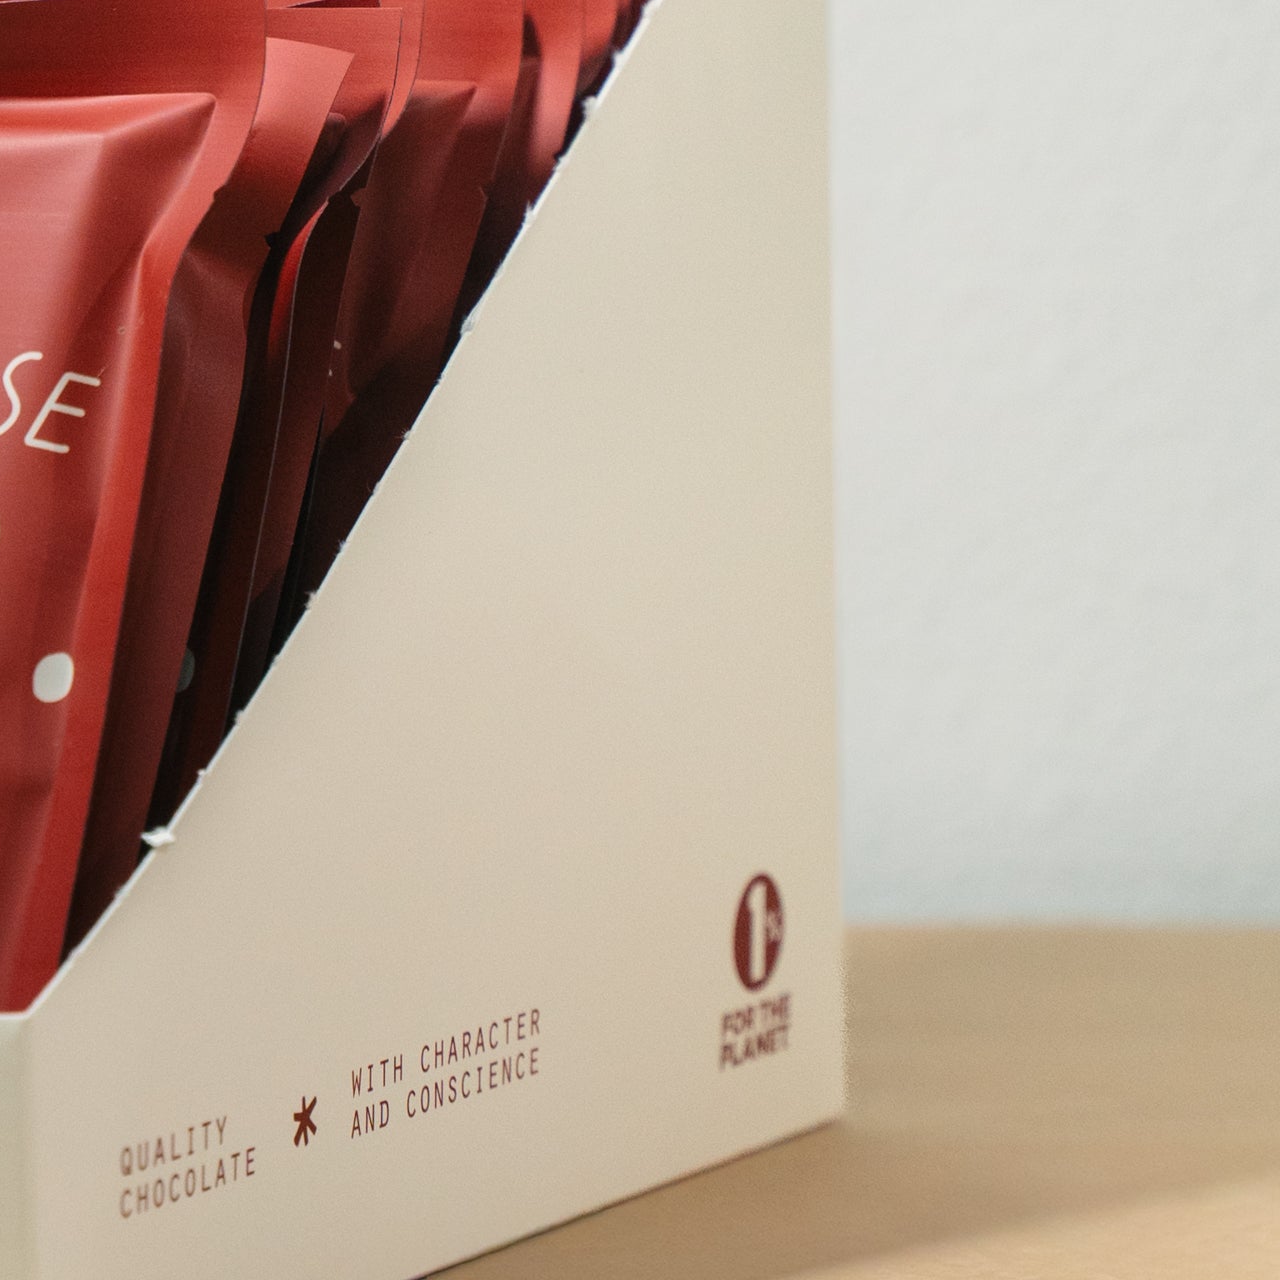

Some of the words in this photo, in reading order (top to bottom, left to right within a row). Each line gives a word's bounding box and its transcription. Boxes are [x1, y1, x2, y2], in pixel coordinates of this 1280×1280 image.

[350, 1053, 404, 1099] WITH
[420, 1008, 541, 1073] CHARACTER
[350, 1100, 390, 1139] AND
[407, 1047, 540, 1119] CONSCIENCE
[120, 1147, 256, 1219] CHOCOLATE
[121, 1116, 228, 1177] QUALITY
